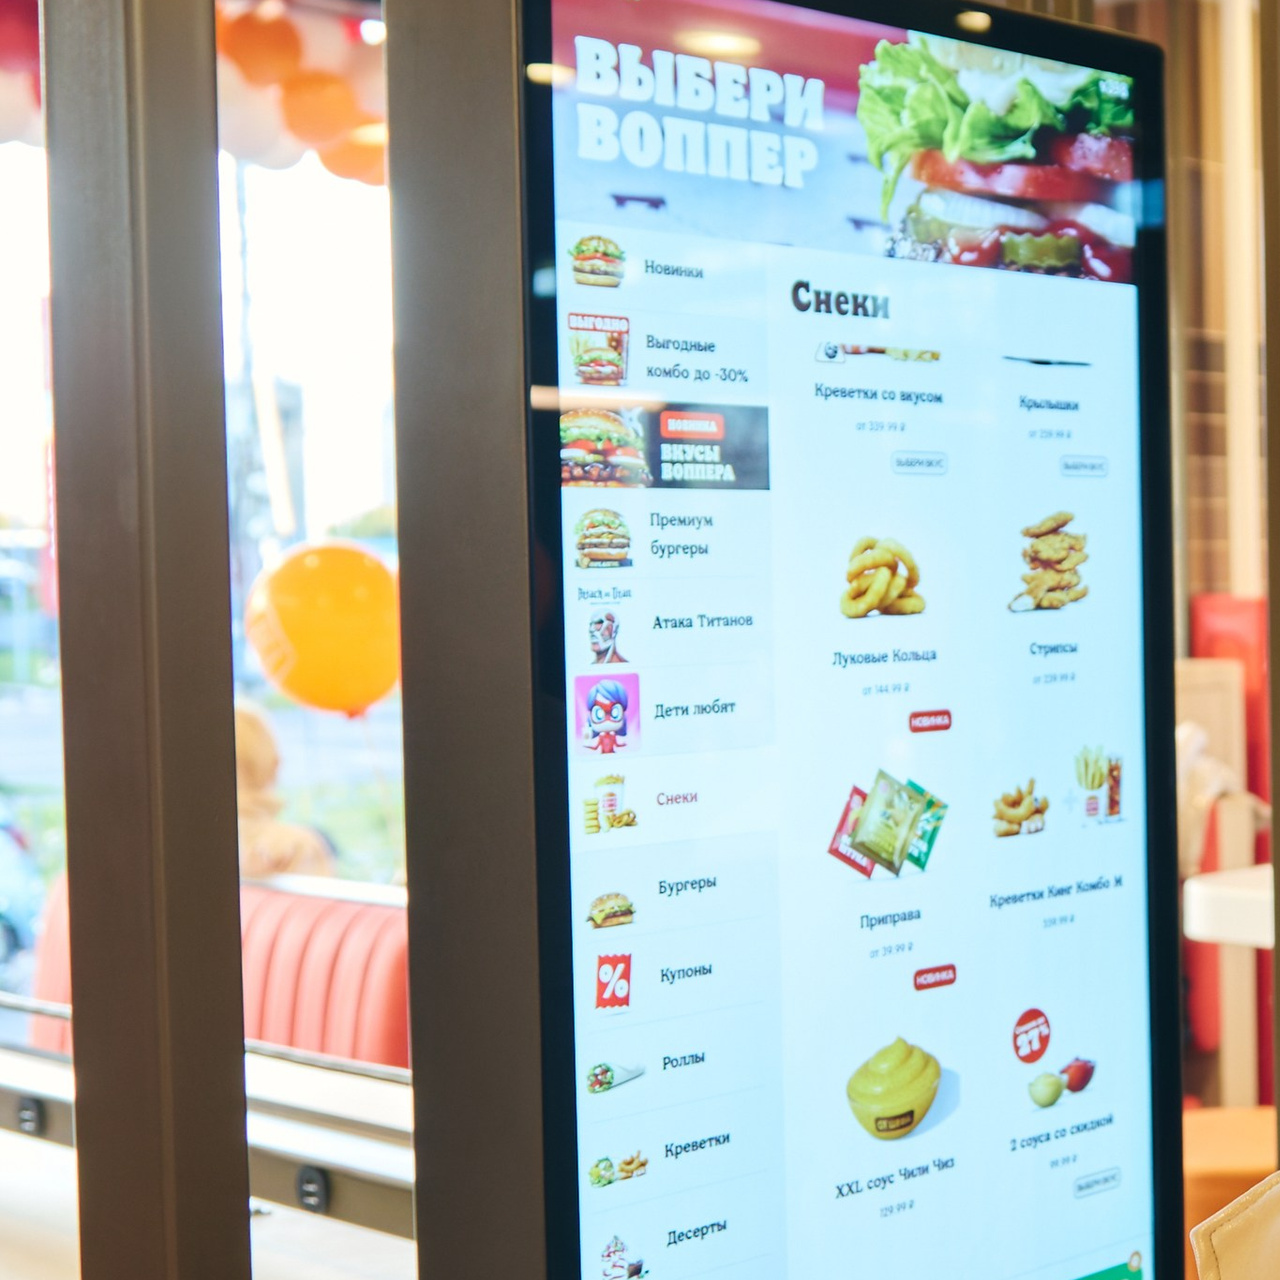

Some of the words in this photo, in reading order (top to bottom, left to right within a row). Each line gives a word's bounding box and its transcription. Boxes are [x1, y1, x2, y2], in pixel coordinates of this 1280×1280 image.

[574, 35, 825, 131] ВЫБЕРИ
[576, 102, 818, 188] ВОППЕР
[644, 260, 704, 279] Новинки
[792, 279, 890, 319] Снеки
[646, 335, 715, 353] Выгодные
[646, 364, 689, 379] комбо
[694, 368, 711, 381] до
[715, 368, 749, 383] -30%
[815, 383, 878, 402] Креветки
[881, 389, 896, 401] со
[900, 390, 943, 405] вкусом
[1020, 395, 1080, 412] Крылышки
[660, 444, 720, 463] ВКУСЫ
[660, 462, 736, 481] ВОППЕРА
[650, 513, 713, 530] Премиум
[651, 540, 708, 558] бургеры
[653, 616, 693, 630] Атака
[698, 613, 753, 628] Титанов
[833, 651, 888, 668] Луковые
[893, 648, 937, 664] Кольца
[1030, 641, 1078, 658] Стрипсы
[654, 704, 689, 720] Дети
[693, 699, 736, 716] любят
[657, 792, 698, 806] Снеки
[659, 875, 717, 896] Бургеры
[990, 887, 1045, 908] Креветки
[1075, 876, 1110, 895] Комбо
[860, 908, 922, 930] Приправа
[661, 964, 713, 984] Купоны
[663, 1052, 705, 1070] Роллы
[664, 1132, 730, 1159] Креветки
[1010, 1138, 1018, 1152] 2
[1020, 1130, 1052, 1150] соуса
[1054, 1127, 1067, 1139] со
[835, 1180, 864, 1199] XXL
[866, 1172, 895, 1191] соус
[898, 1163, 930, 1181] Чили
[933, 1157, 956, 1174] Чиз
[667, 1219, 727, 1247] Десерты
